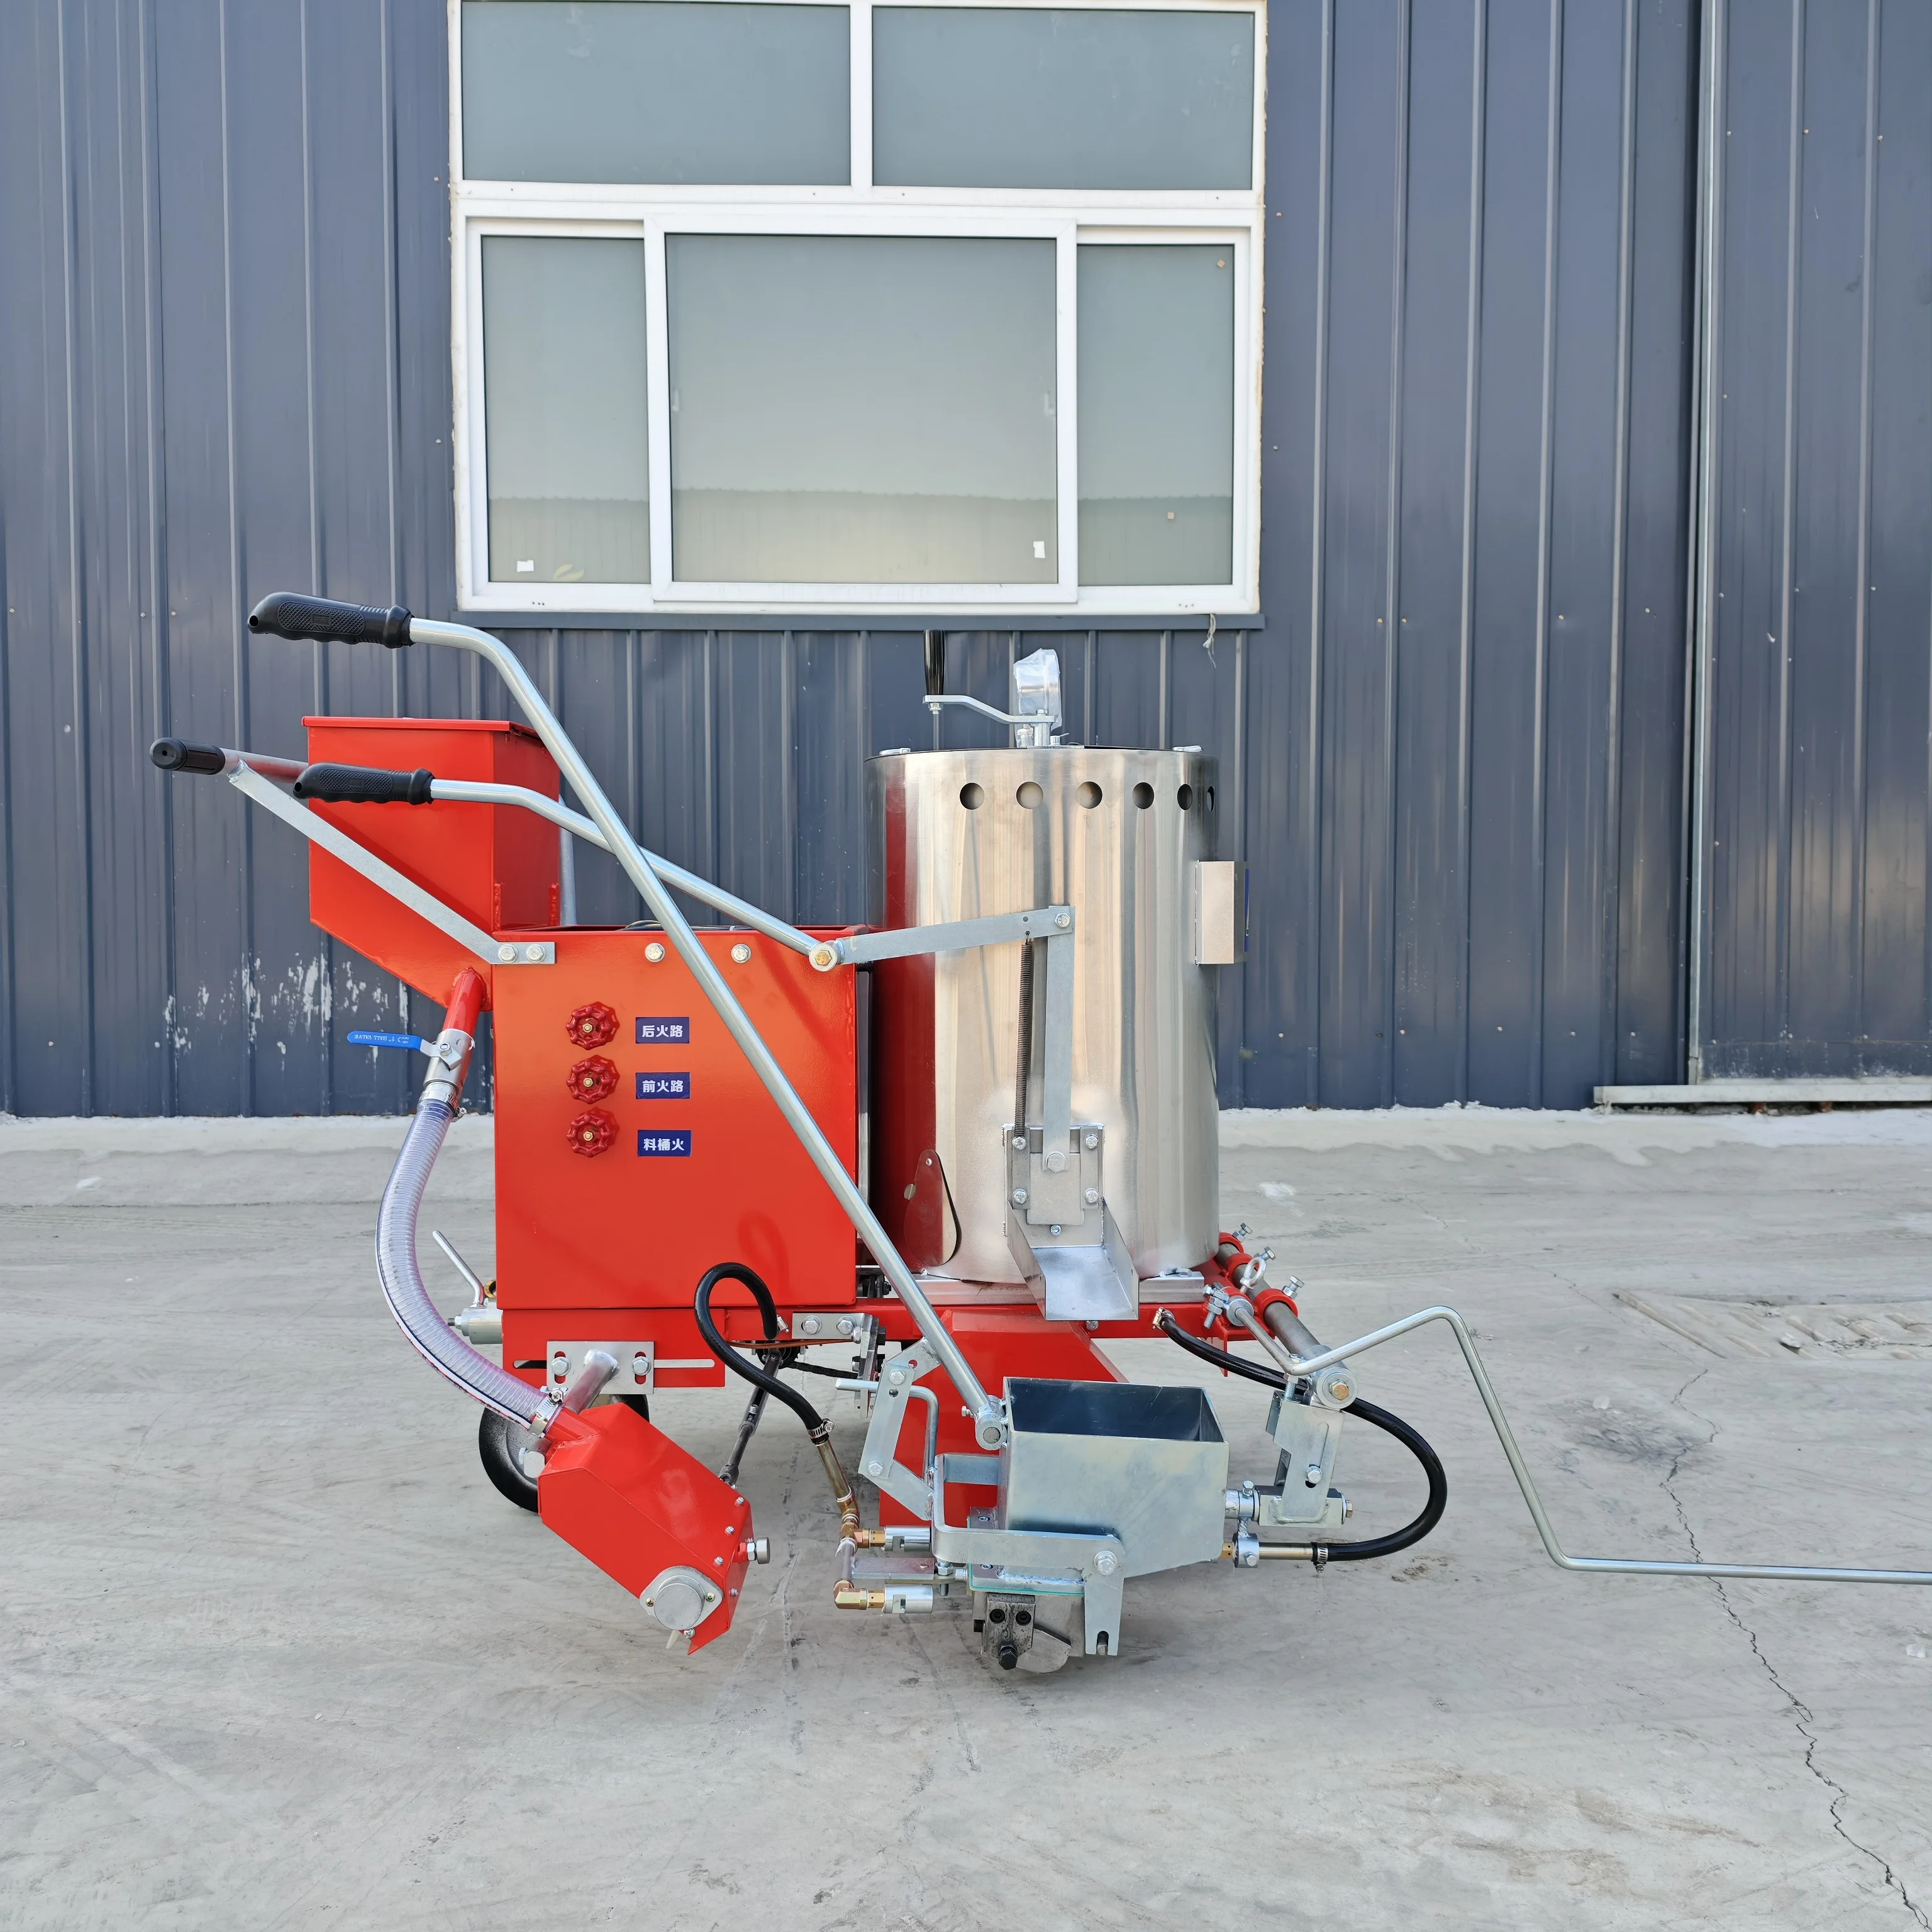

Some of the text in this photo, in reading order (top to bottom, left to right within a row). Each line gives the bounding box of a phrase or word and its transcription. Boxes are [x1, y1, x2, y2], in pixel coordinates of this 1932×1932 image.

[641, 1024, 683, 1038] 后火路
[642, 1079, 684, 1093] 前火路
[643, 1138, 685, 1152] 料桶火
